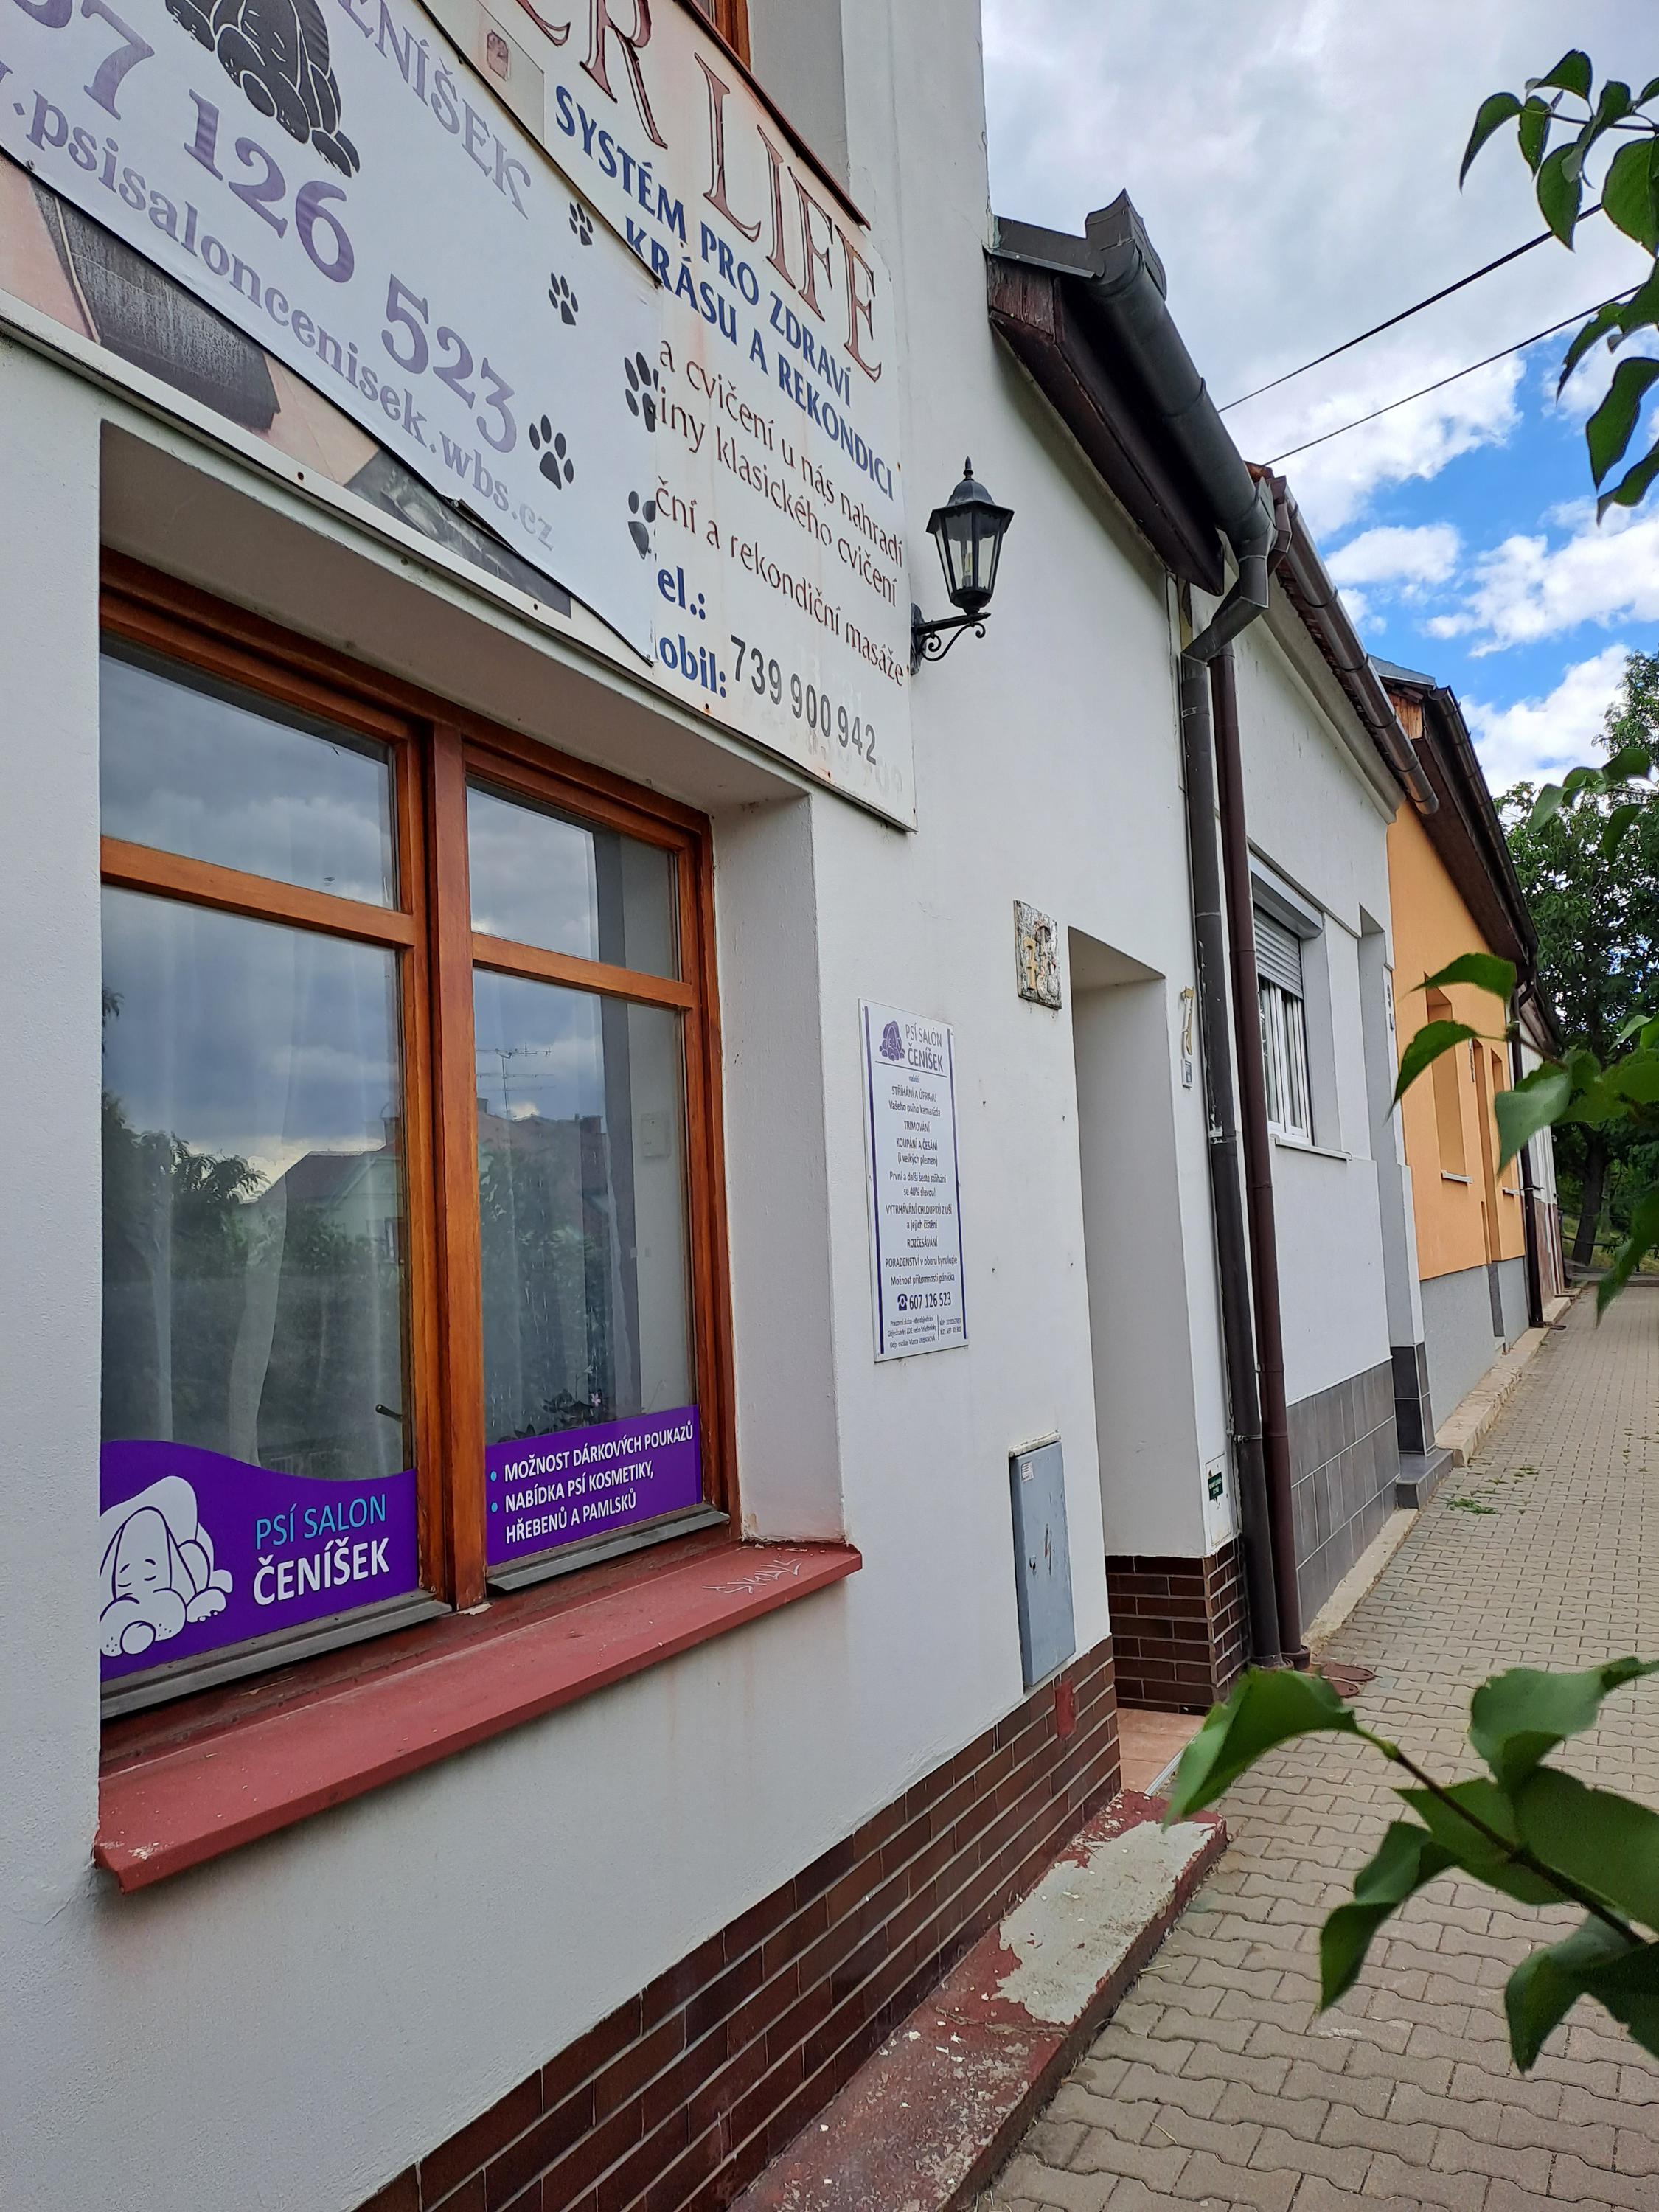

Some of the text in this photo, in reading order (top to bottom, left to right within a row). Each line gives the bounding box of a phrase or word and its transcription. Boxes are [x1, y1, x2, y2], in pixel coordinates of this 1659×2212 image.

[13, 0, 517, 453] 7 126 523
[695, 52, 881, 382] LIFE
[555, 86, 852, 409] SYSTÉM PRO ZDRAVÍ
[625, 215, 894, 501] KRÁSU A REKONDICI
[686, 361, 774, 451] cvičení
[782, 438, 796, 470] u
[801, 456, 834, 505] nás
[841, 491, 903, 569] nahradí
[716, 424, 832, 546] klasického
[838, 538, 897, 608] cvičení
[706, 520, 722, 549] a
[731, 532, 841, 636] rekondiční
[846, 622, 904, 687] masáže
[731, 633, 782, 706] 739
[790, 672, 832, 737] 900
[838, 705, 877, 766] 942
[905, 1023, 917, 1040] PSÍ
[908, 1043, 944, 1073] ČENÍŠEK
[891, 1084, 937, 1102] STŘÍHÁNÍ A ÚPRAVU
[888, 1099, 906, 1112] Vašeho
[903, 1120, 931, 1133] TRIMOVÁNÍ
[896, 1137, 938, 1151] KOUPÁNÍ A ČESÁNÍ
[902, 1153, 920, 1165] velkých
[920, 1155, 938, 1166] plemen)
[889, 1171, 902, 1180] První
[903, 1188, 909, 1196] se
[886, 1203, 917, 1214] VYTRHÁVÁNÍ
[917, 1203, 942, 1215] CHLOUPKŮ
[906, 1222, 910, 1230] a
[910, 1220, 923, 1231] jejich
[907, 1235, 938, 1248] ROZČESÁVÁNÍ
[885, 1255, 919, 1268] PORADENSTVÍ
[920, 1258, 924, 1266] v
[891, 1275, 912, 1286] Možnost
[909, 1291, 952, 1310] 607 126 523
[504, 1419, 693, 1483] MOŽNOST DÁRKOVÝCH POUKAZŮ
[505, 1460, 654, 1513] NABÍDKA PSÍ KOSMETIKY,
[256, 1494, 386, 1550] PSÍ SALON
[506, 1488, 637, 1545] HŘEBENŮ A PAMLSKŮ
[253, 1536, 390, 1606] ČENÍŠEK
